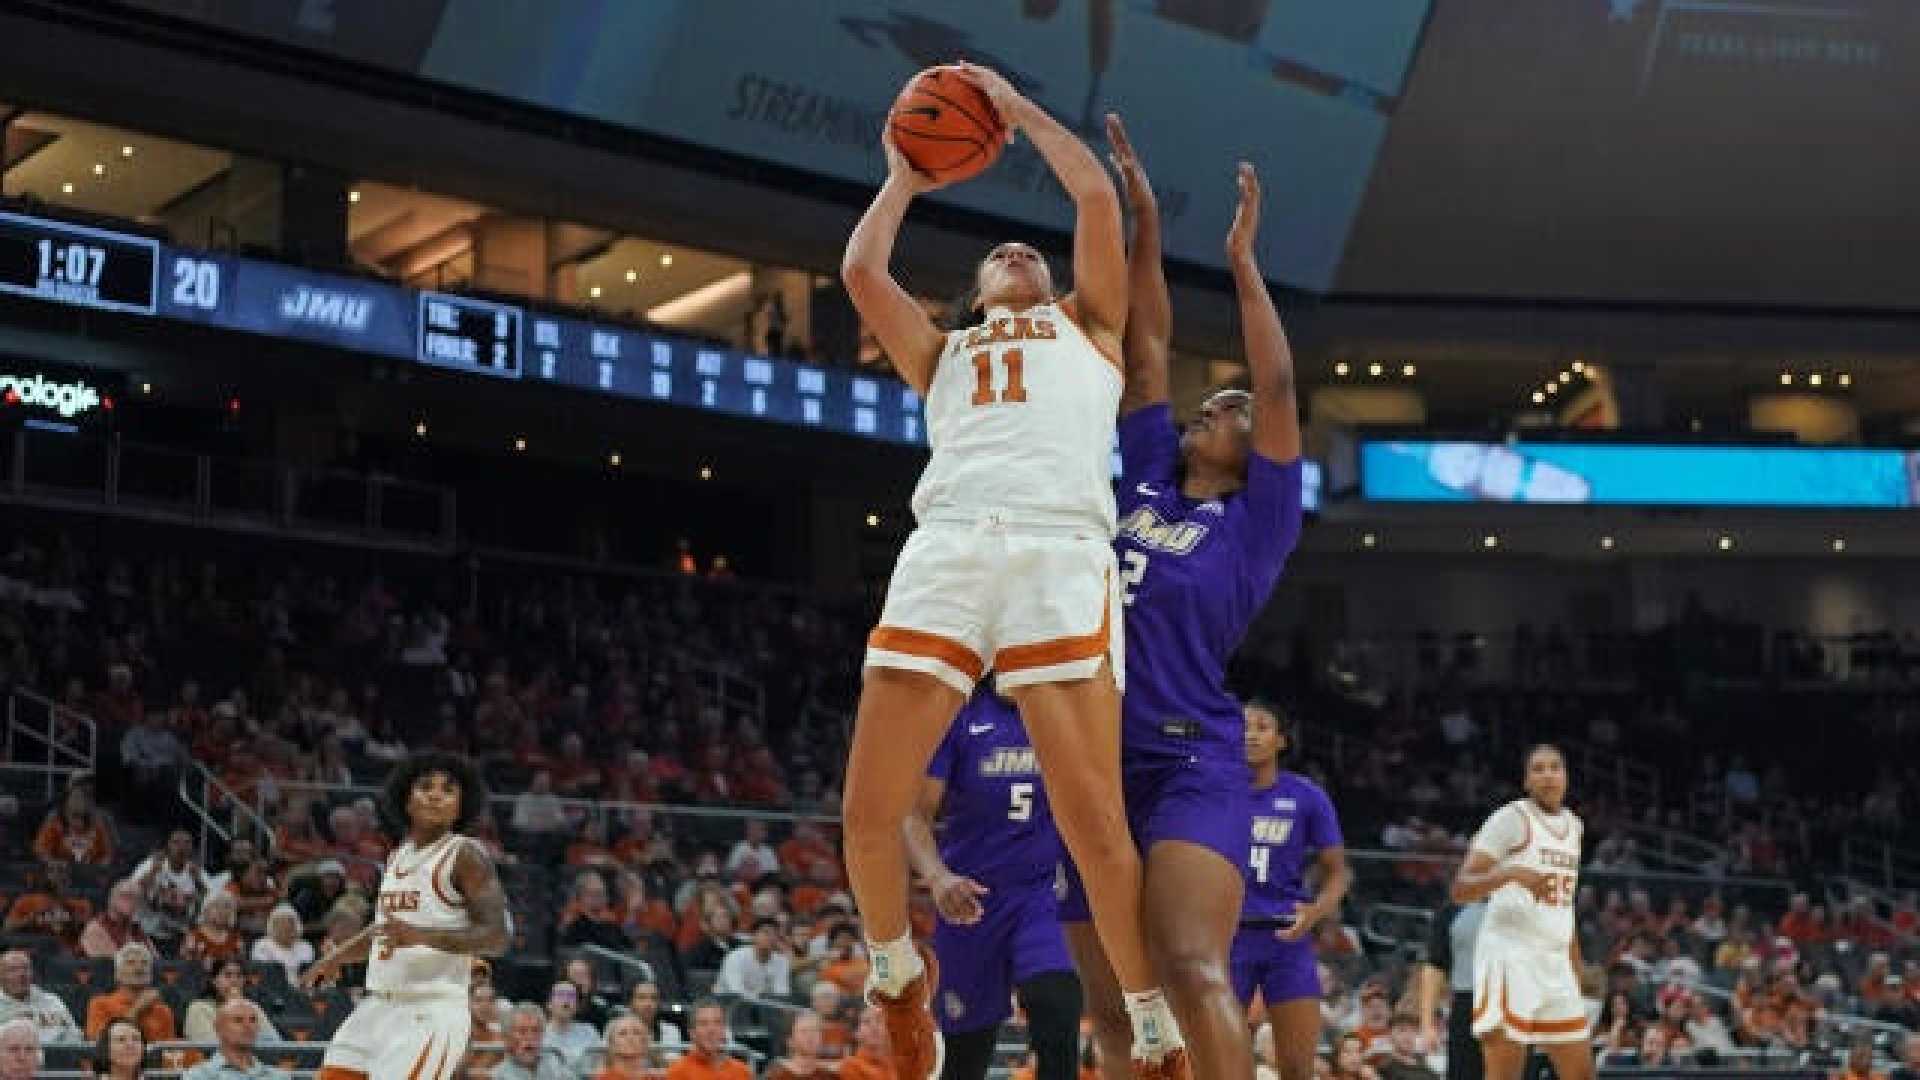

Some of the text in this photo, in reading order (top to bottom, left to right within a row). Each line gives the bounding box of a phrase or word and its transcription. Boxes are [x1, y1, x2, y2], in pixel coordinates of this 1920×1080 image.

[38, 239, 105, 287] 1:07
[174, 257, 219, 309] 20
[281, 287, 370, 331] JMU
[971, 348, 1026, 406] 11
[977, 748, 1042, 776] JM
[1007, 782, 1034, 821] 5
[1249, 846, 1270, 884] 4
